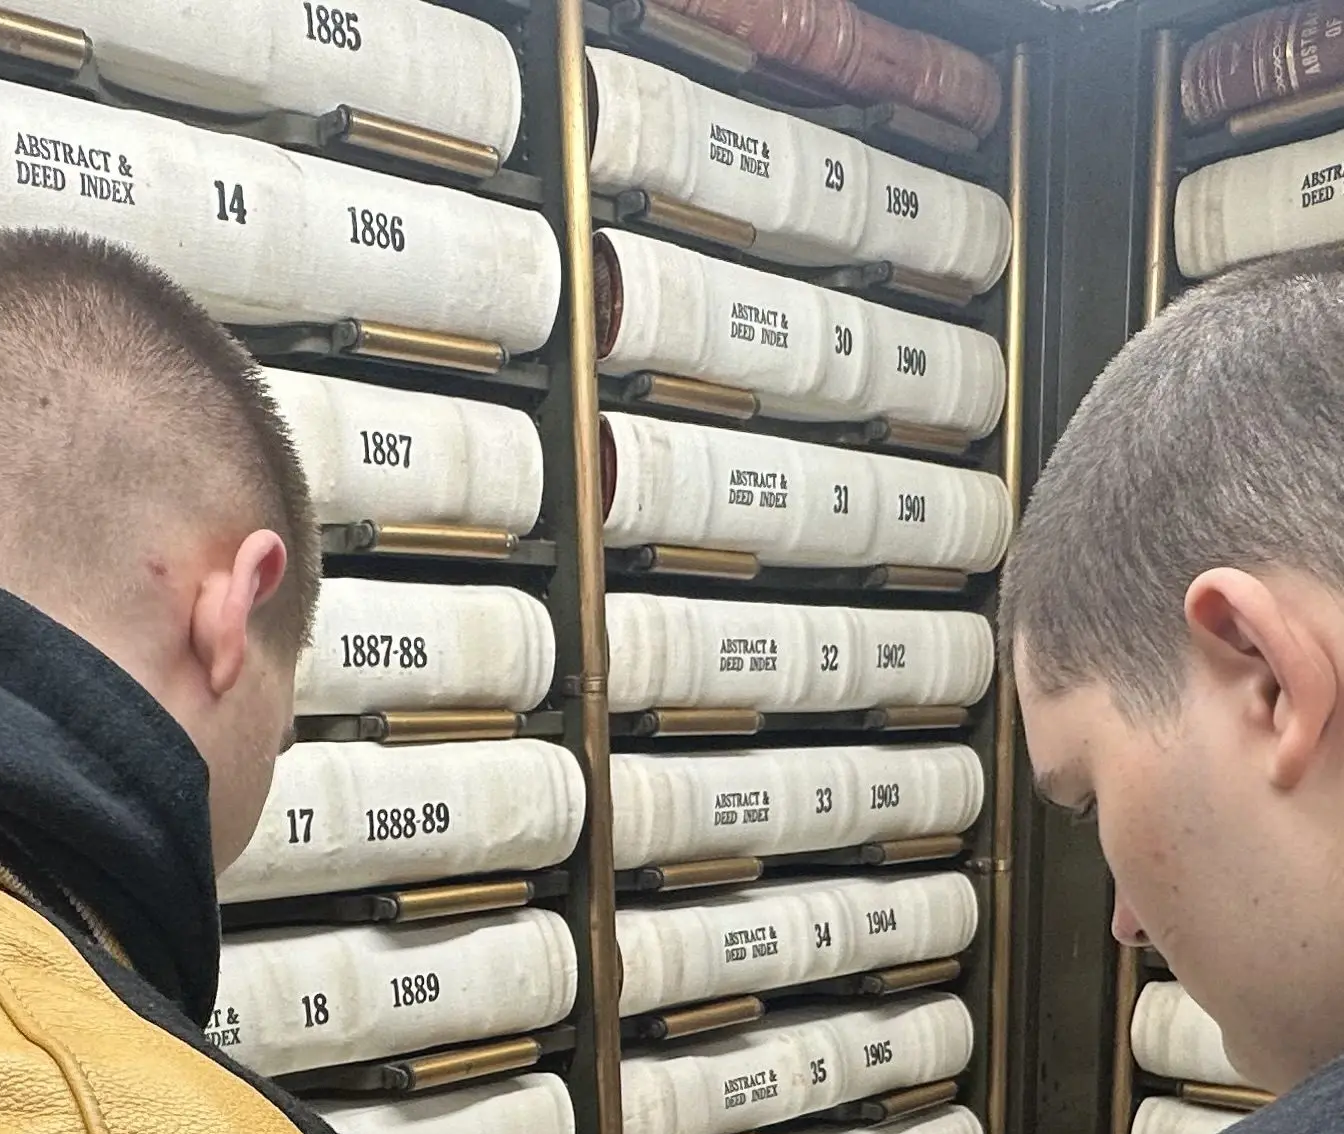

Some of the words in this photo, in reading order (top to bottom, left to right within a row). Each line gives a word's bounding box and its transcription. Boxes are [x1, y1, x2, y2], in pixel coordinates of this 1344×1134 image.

[304, 2, 362, 52] 1885
[710, 122, 759, 155] ABSTRACT
[761, 142, 770, 159] &
[15, 131, 113, 172] ABSTRACT
[116, 154, 133, 178] &
[710, 145, 734, 167] DEED
[740, 153, 770, 178] INDEX
[16, 159, 66, 191] DEED
[79, 172, 136, 205] INDEX
[825, 158, 845, 192] 29
[214, 180, 248, 224] 14
[886, 185, 919, 219] 1899
[1301, 187, 1335, 209] DEED
[347, 206, 405, 252] 1886
[731, 302, 777, 327] ABSTRACT
[780, 313, 788, 329] &
[730, 321, 755, 342] DEED
[761, 330, 788, 348] INDEX
[835, 325, 852, 356] 30
[897, 346, 926, 376] 1900
[360, 430, 413, 468] 1887
[729, 470, 777, 489] ABSTRACT
[780, 475, 787, 490] &
[728, 489, 754, 507] DEED
[759, 492, 787, 508] INDEX
[833, 485, 849, 514] 31
[898, 494, 925, 522] 1901
[341, 634, 428, 669] 1887-88
[720, 639, 767, 654] ABSTRACT
[769, 639, 778, 654] &
[821, 645, 838, 671] 32
[876, 644, 905, 669] 1902
[720, 656, 744, 672] DEED
[749, 657, 777, 671] INDEX
[715, 792, 760, 809] ABSTRACT
[762, 791, 769, 805] &
[816, 788, 832, 813] 33
[870, 783, 899, 809] 1903
[286, 808, 315, 843] 17
[365, 803, 450, 842] 1888-89
[714, 811, 737, 825] DEED
[742, 808, 770, 824] INDEX
[866, 908, 896, 934] 1904
[724, 927, 767, 947] ABSTRACT
[769, 926, 777, 939] &
[815, 922, 831, 948] 34
[725, 948, 747, 962] DEED
[752, 941, 778, 958] INDEX
[390, 973, 440, 1008] 1889
[227, 1006, 239, 1025] &
[301, 993, 329, 1027] 18
[863, 1040, 892, 1067] 1905
[724, 1071, 766, 1095] ABSTRACT
[769, 1069, 777, 1082] &
[810, 1059, 826, 1085] 35
[725, 1093, 746, 1109] DEED
[751, 1084, 778, 1103] INDEX
